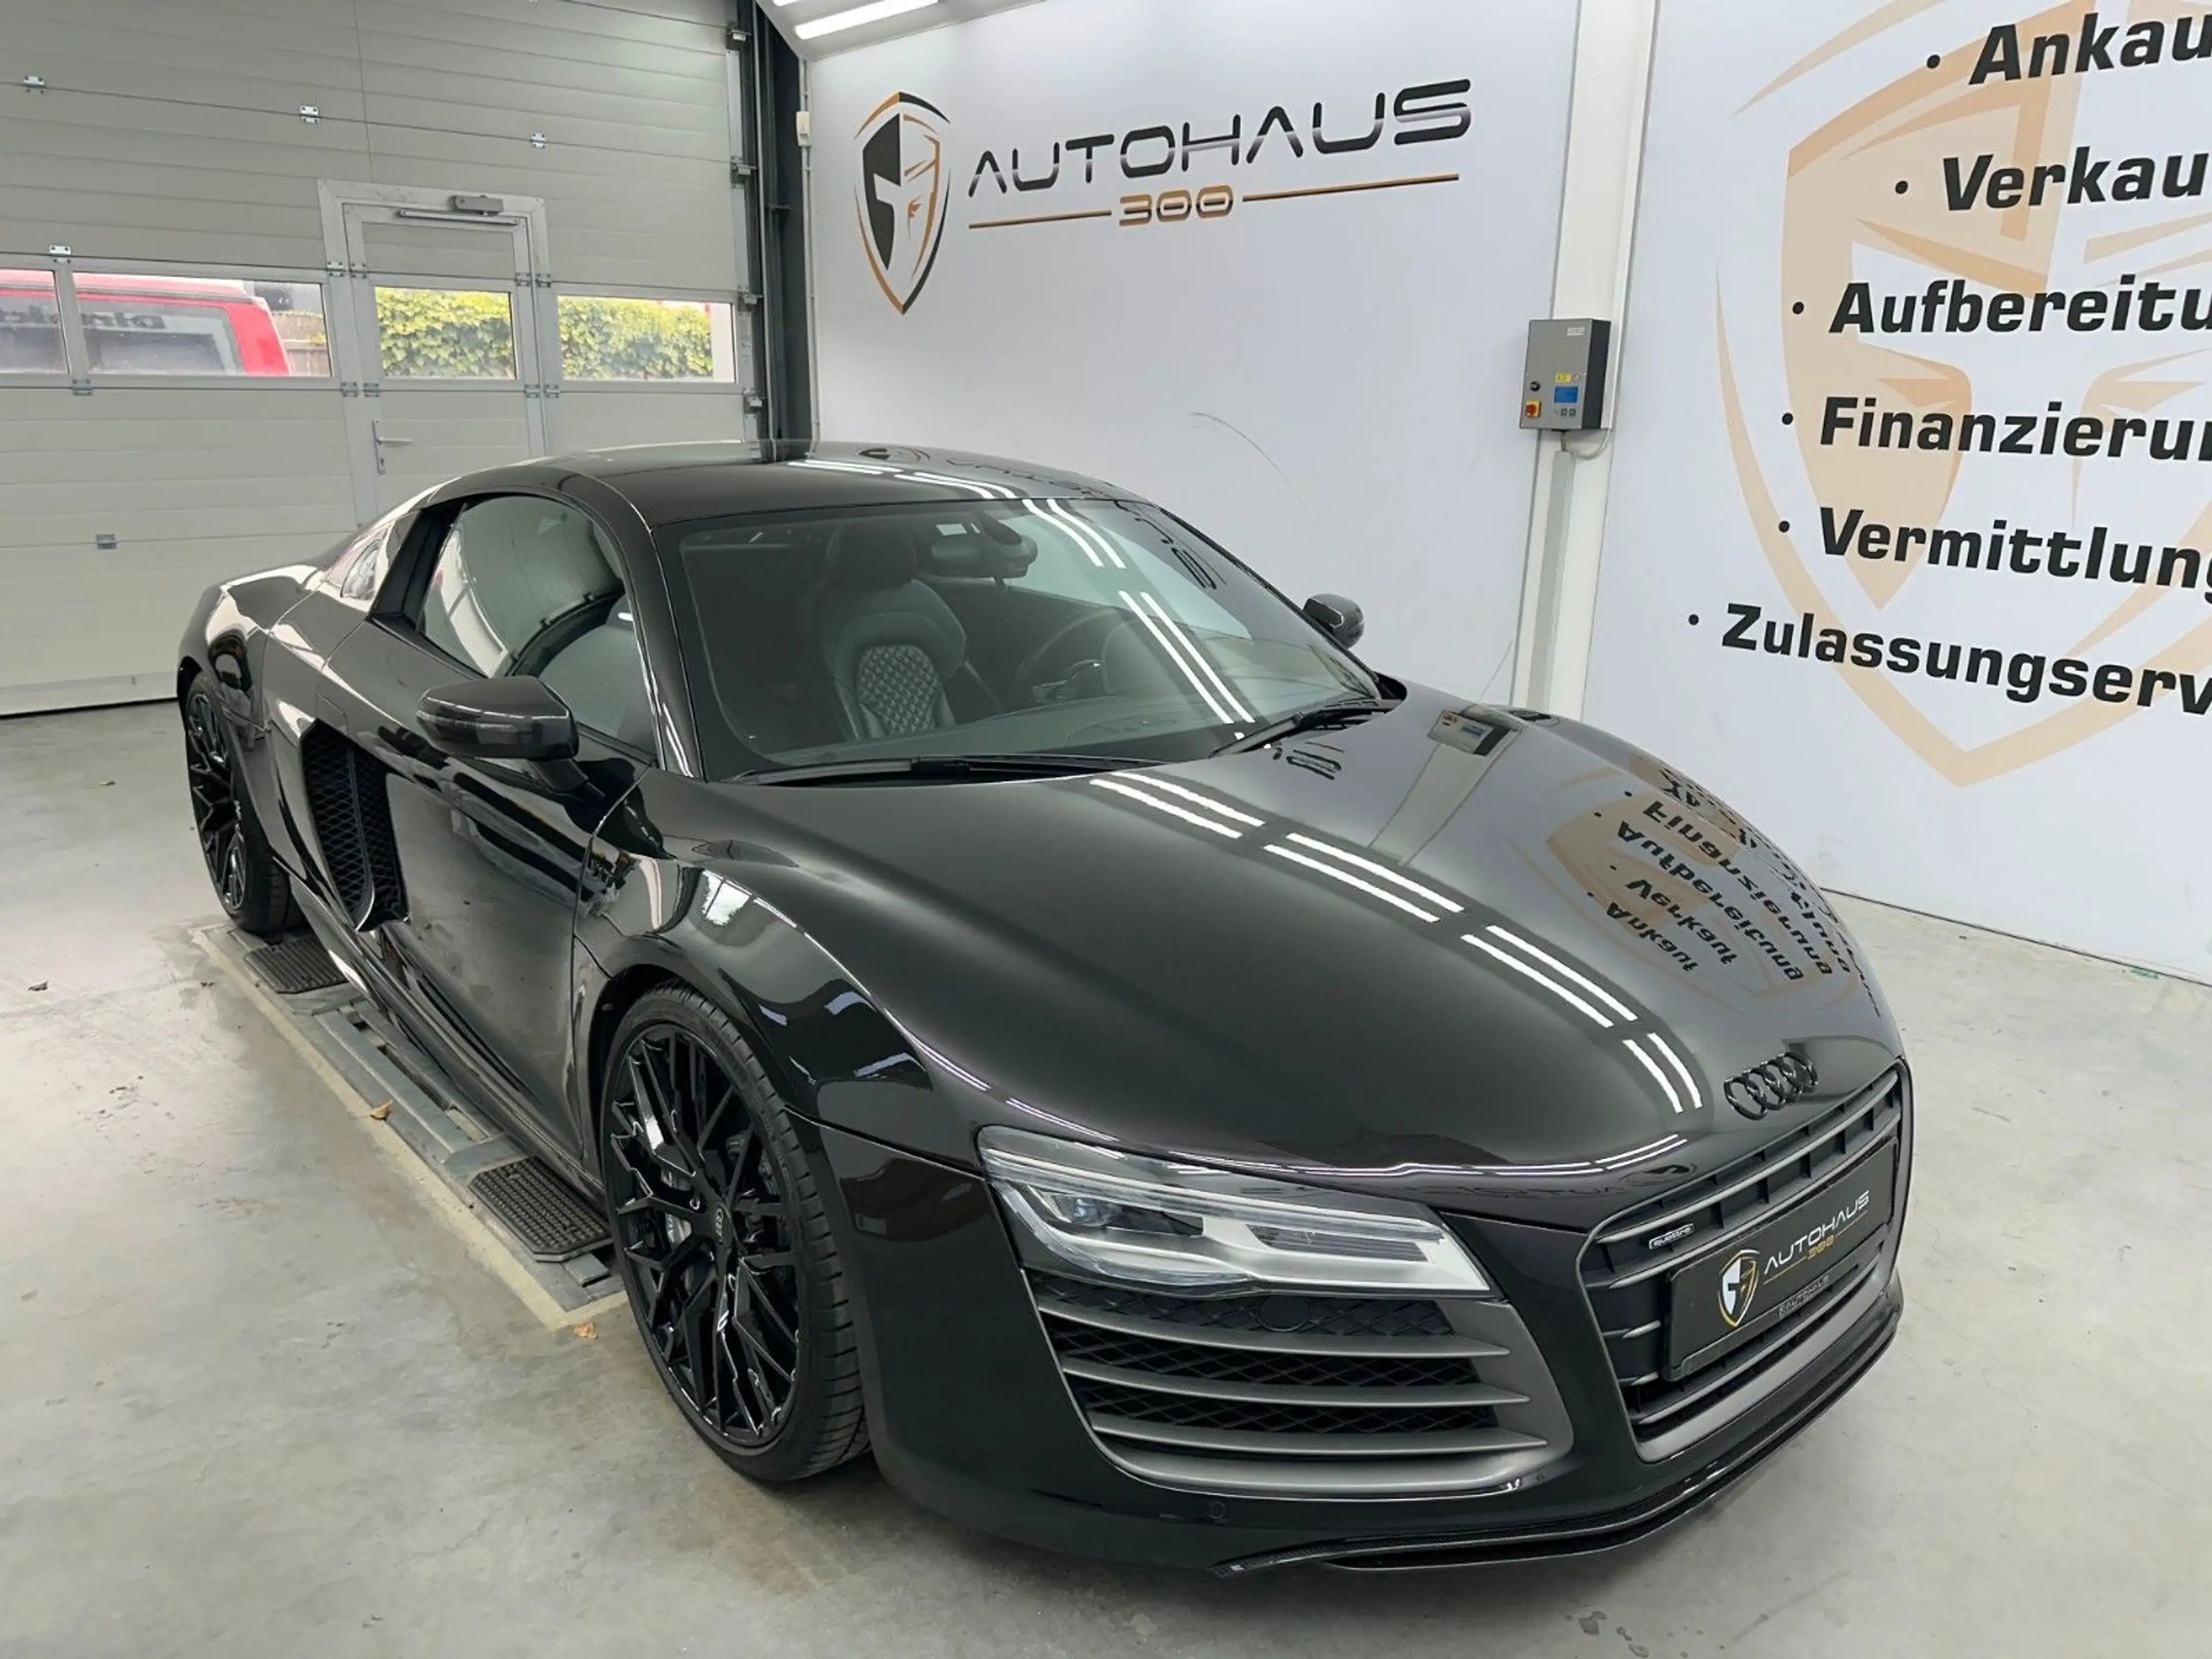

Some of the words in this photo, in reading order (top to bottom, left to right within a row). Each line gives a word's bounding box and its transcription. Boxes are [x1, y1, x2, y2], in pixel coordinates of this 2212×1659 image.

[1968, 13, 2212, 85] Ankau
[968, 79, 1471, 197] AUTOHAUS
[1119, 185, 1234, 226] 300
[1943, 146, 2209, 211] Verkau
[1829, 274, 2212, 333] Aufbereitu
[1820, 507, 2212, 604] Vermittlun
[1721, 603, 2212, 715] Zulassungserv
[1764, 1190, 1869, 1275] AUTOHAUS
